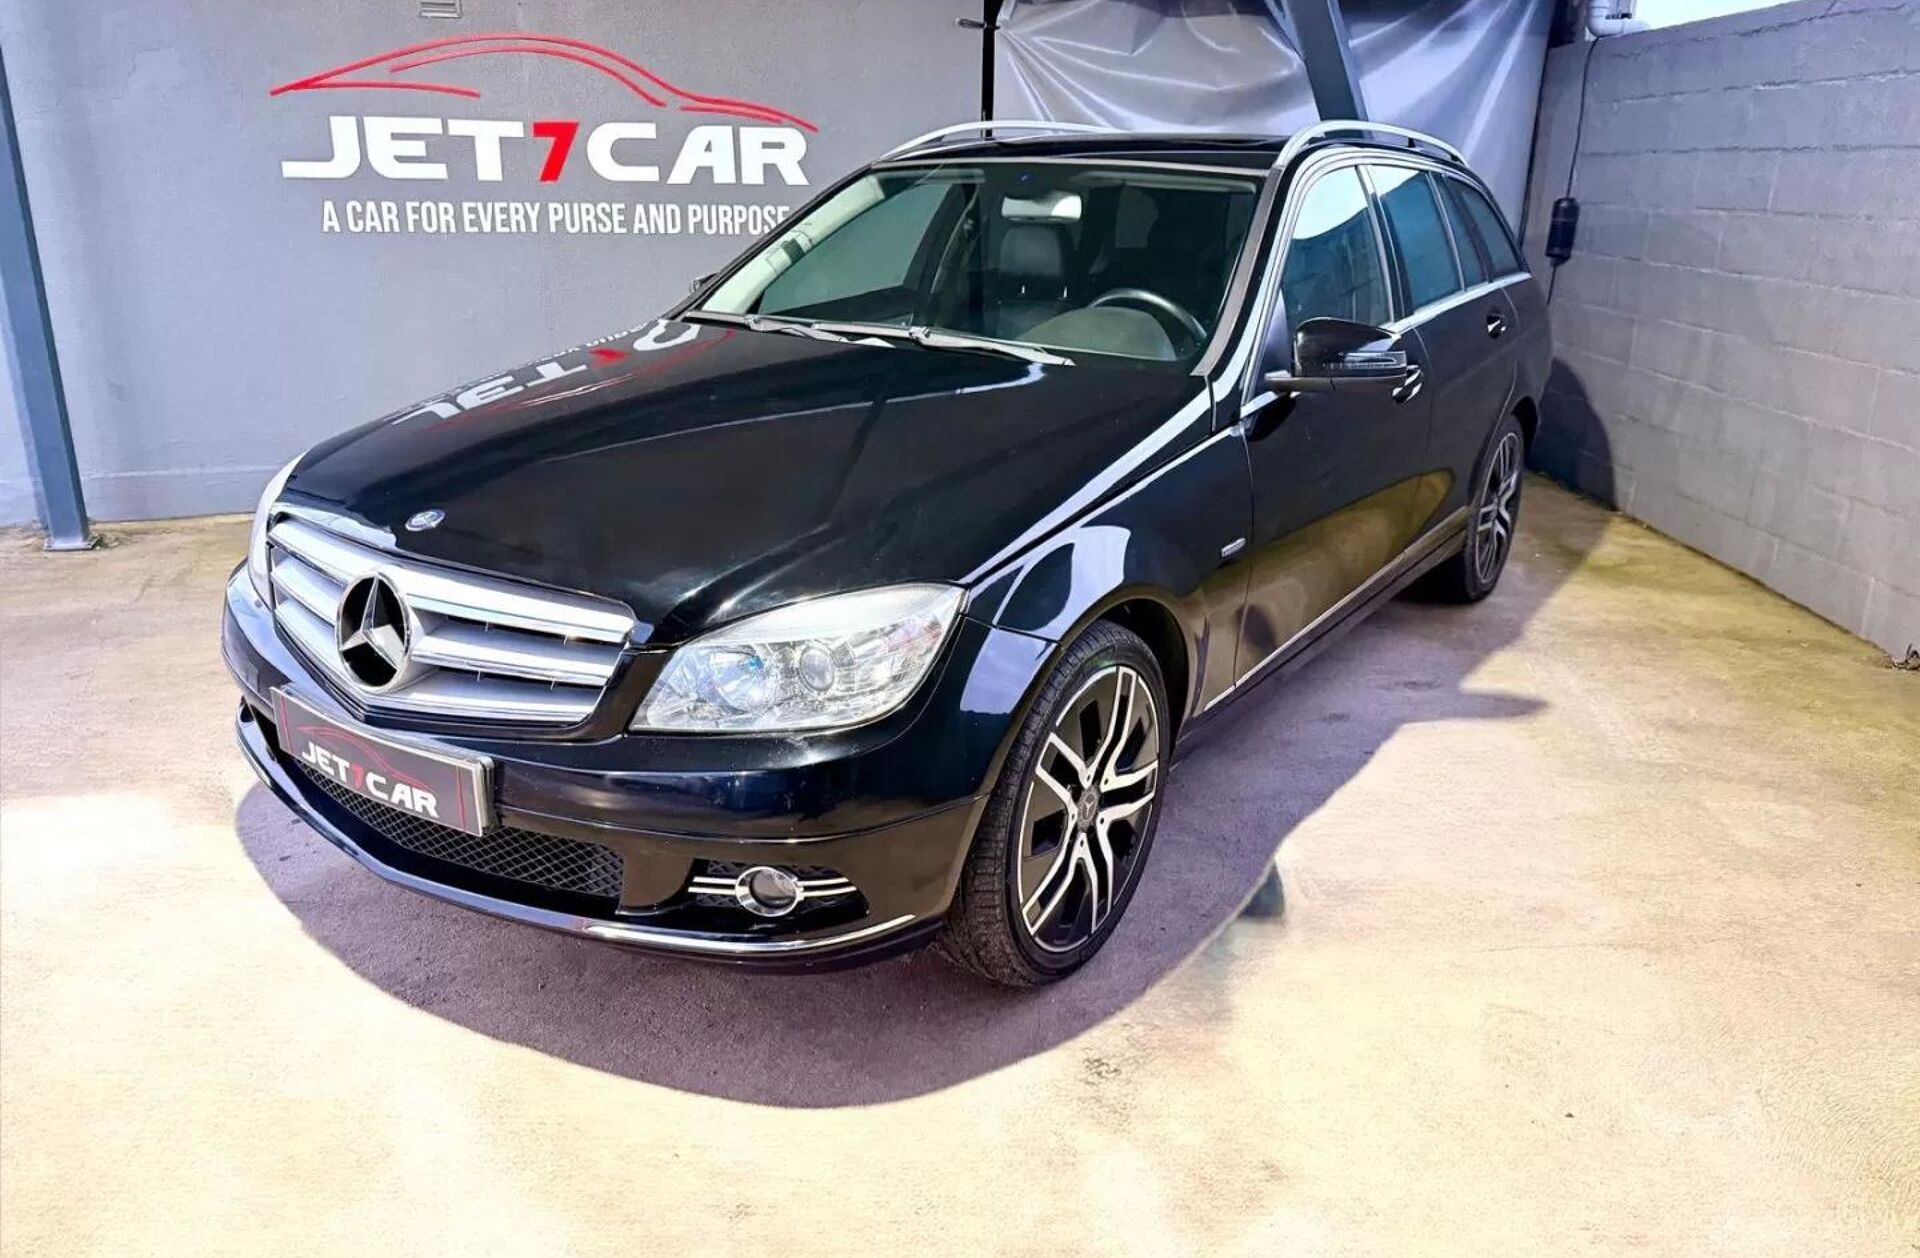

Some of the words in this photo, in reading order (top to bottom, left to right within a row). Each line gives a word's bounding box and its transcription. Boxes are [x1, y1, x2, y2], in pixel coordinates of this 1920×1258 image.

[322, 200, 341, 233] A
[346, 200, 400, 233] CAR
[405, 201, 457, 234] FOR
[462, 202, 541, 233] EVERY
[547, 202, 627, 234] PURSE
[633, 203, 681, 234] AND
